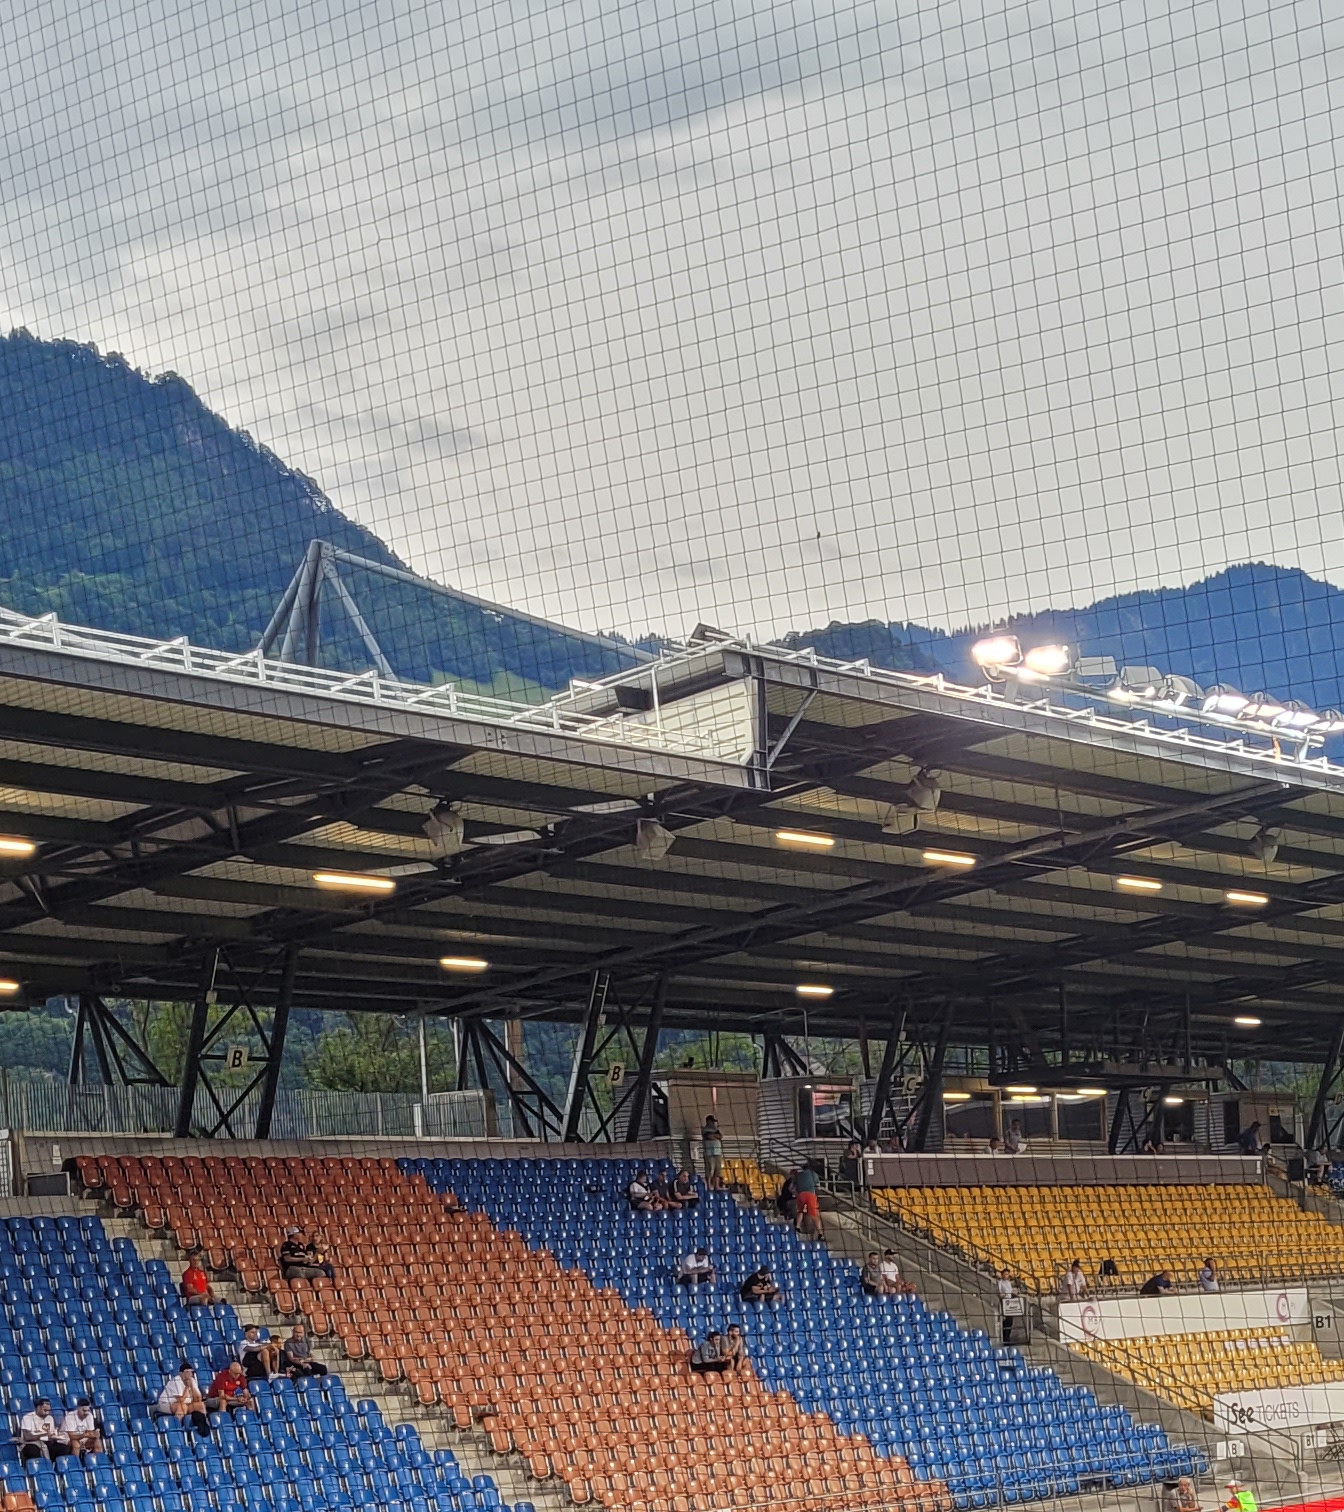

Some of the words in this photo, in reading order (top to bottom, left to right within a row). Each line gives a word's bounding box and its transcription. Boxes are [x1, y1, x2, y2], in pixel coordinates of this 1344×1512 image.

[231, 1050, 243, 1068] B
[611, 1065, 622, 1082] B
[1315, 1315, 1332, 1329] B1
[1231, 1402, 1254, 1425] See
[1256, 1401, 1300, 1422] TICKETS
[1231, 1443, 1238, 1456] B
